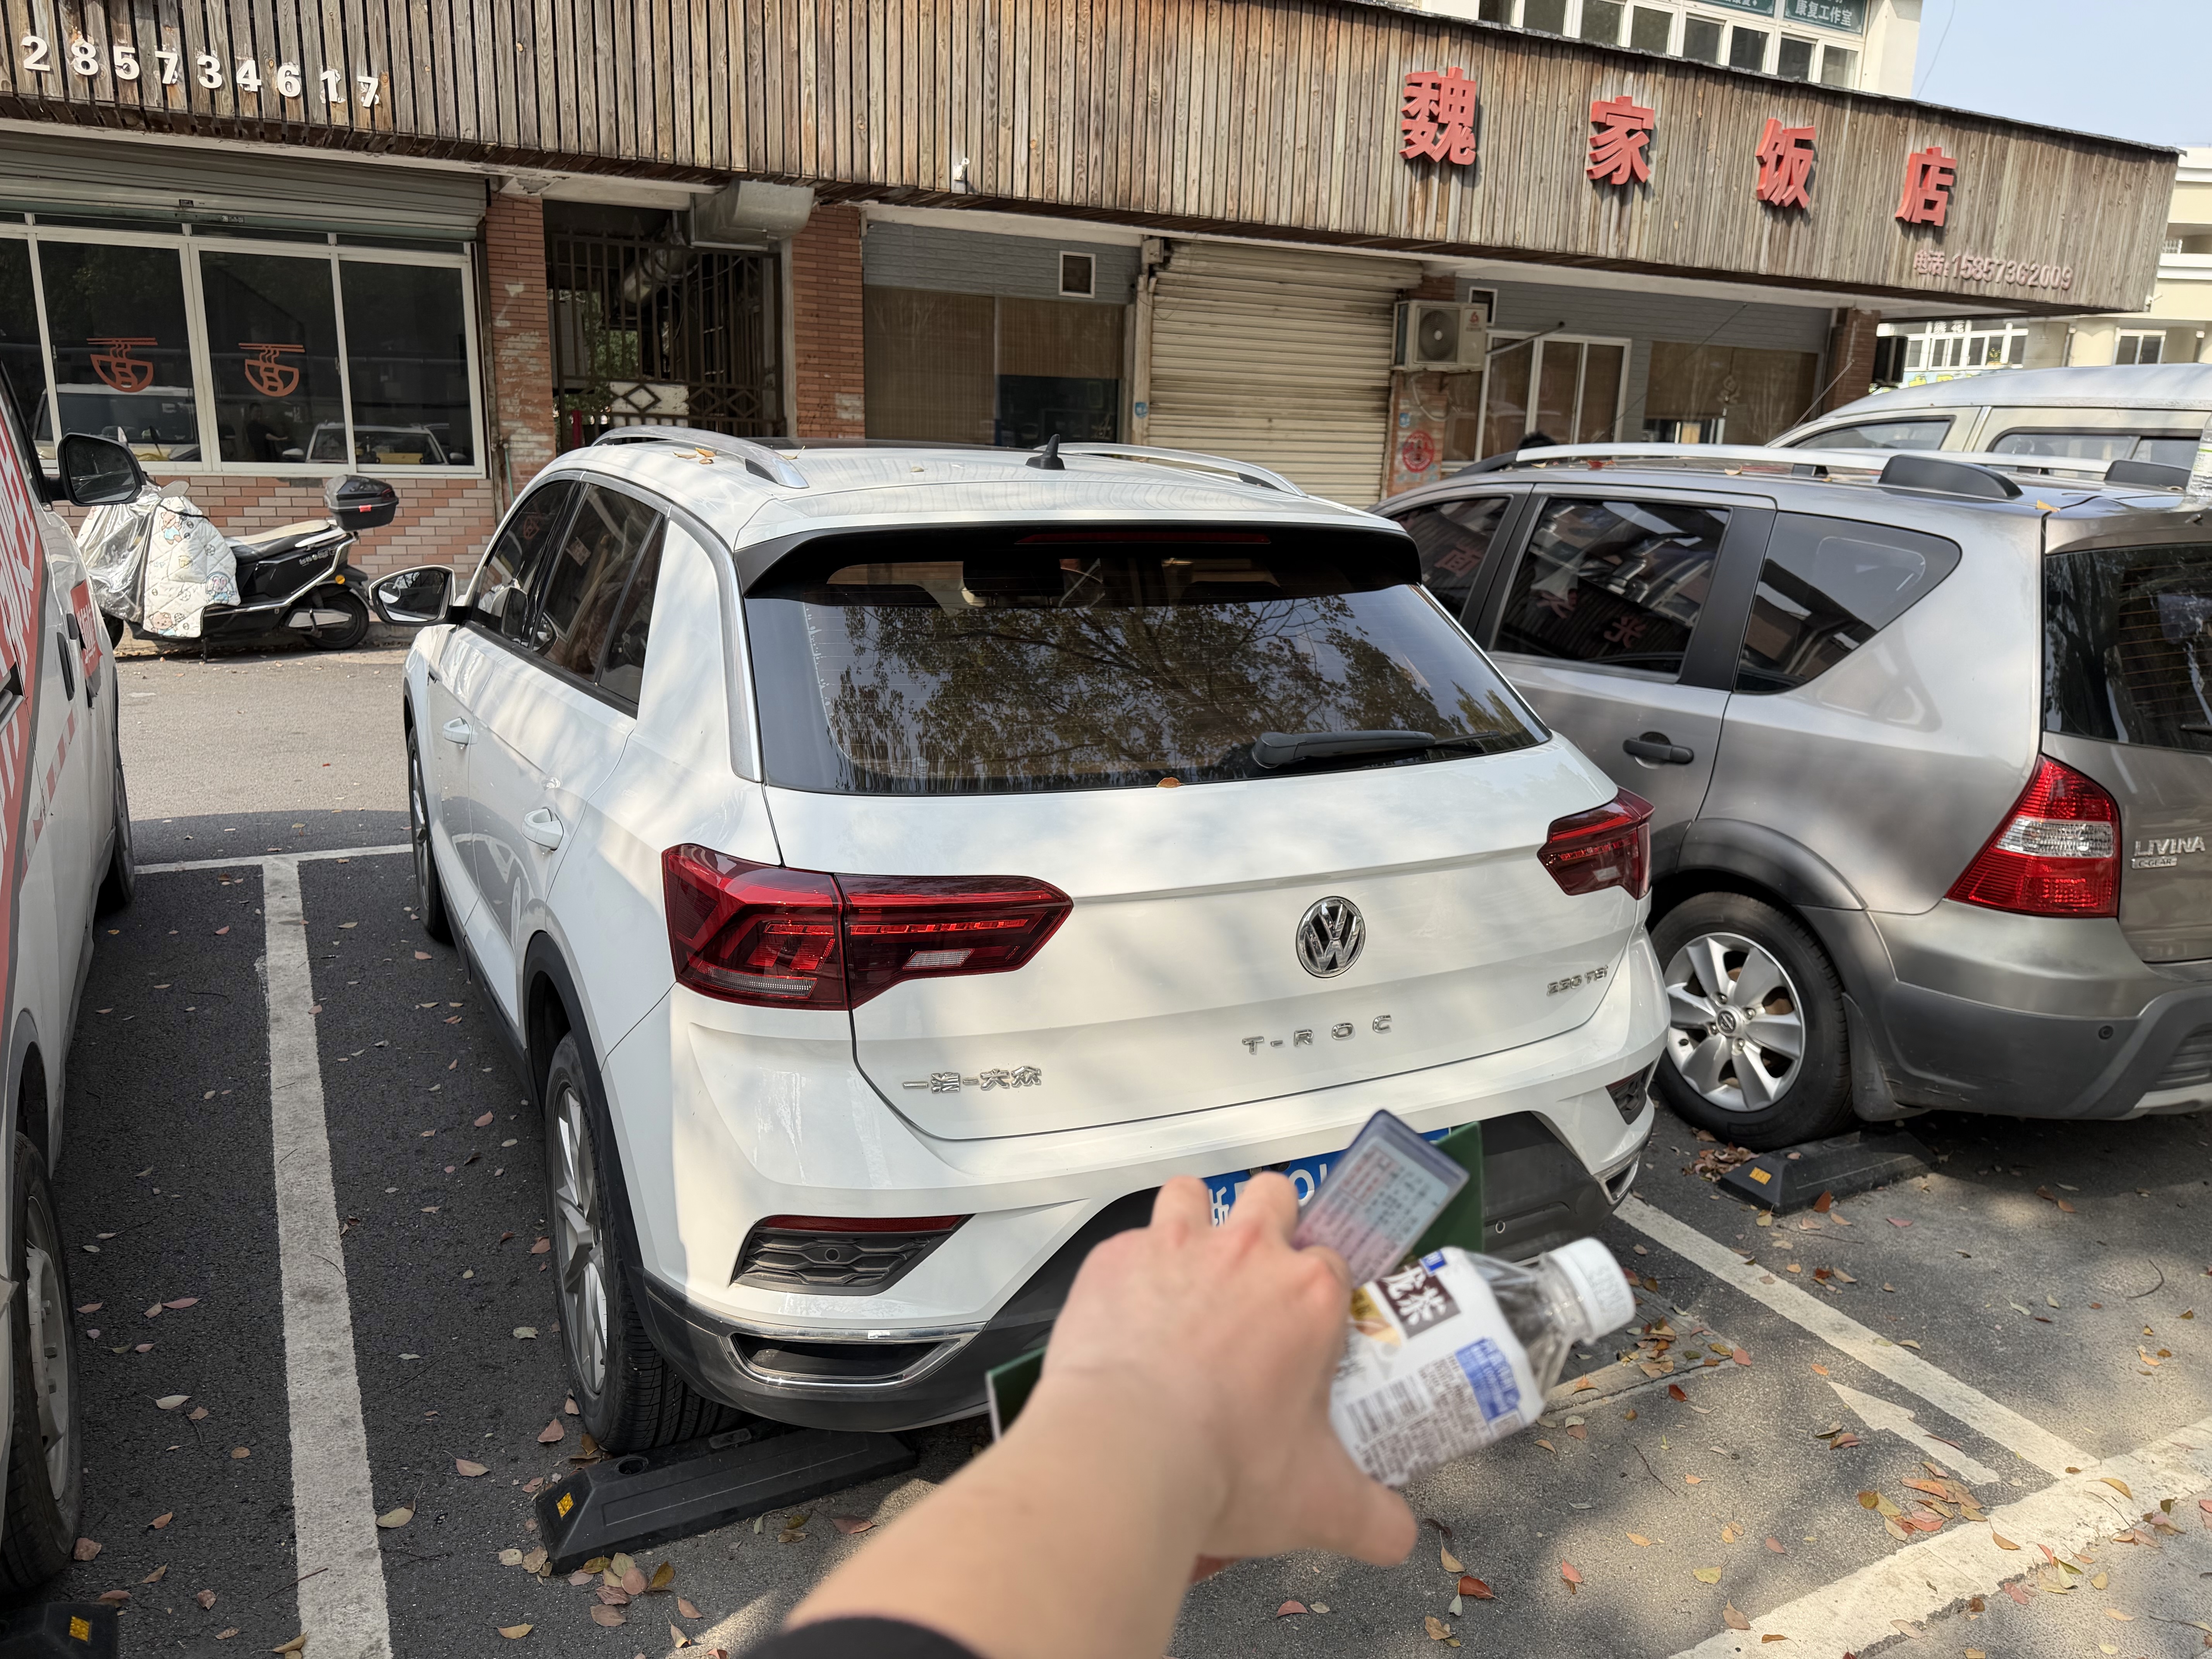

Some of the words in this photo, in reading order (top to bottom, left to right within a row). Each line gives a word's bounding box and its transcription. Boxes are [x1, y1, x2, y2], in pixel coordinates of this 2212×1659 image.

[1795, 0, 1853, 27] 康复工作室
[21, 35, 380, 108] 285734617
[1399, 66, 1957, 227] 魏家饭店
[2134, 836, 2206, 857] LIVINA
[1242, 1014, 1393, 1055] T-ROC
